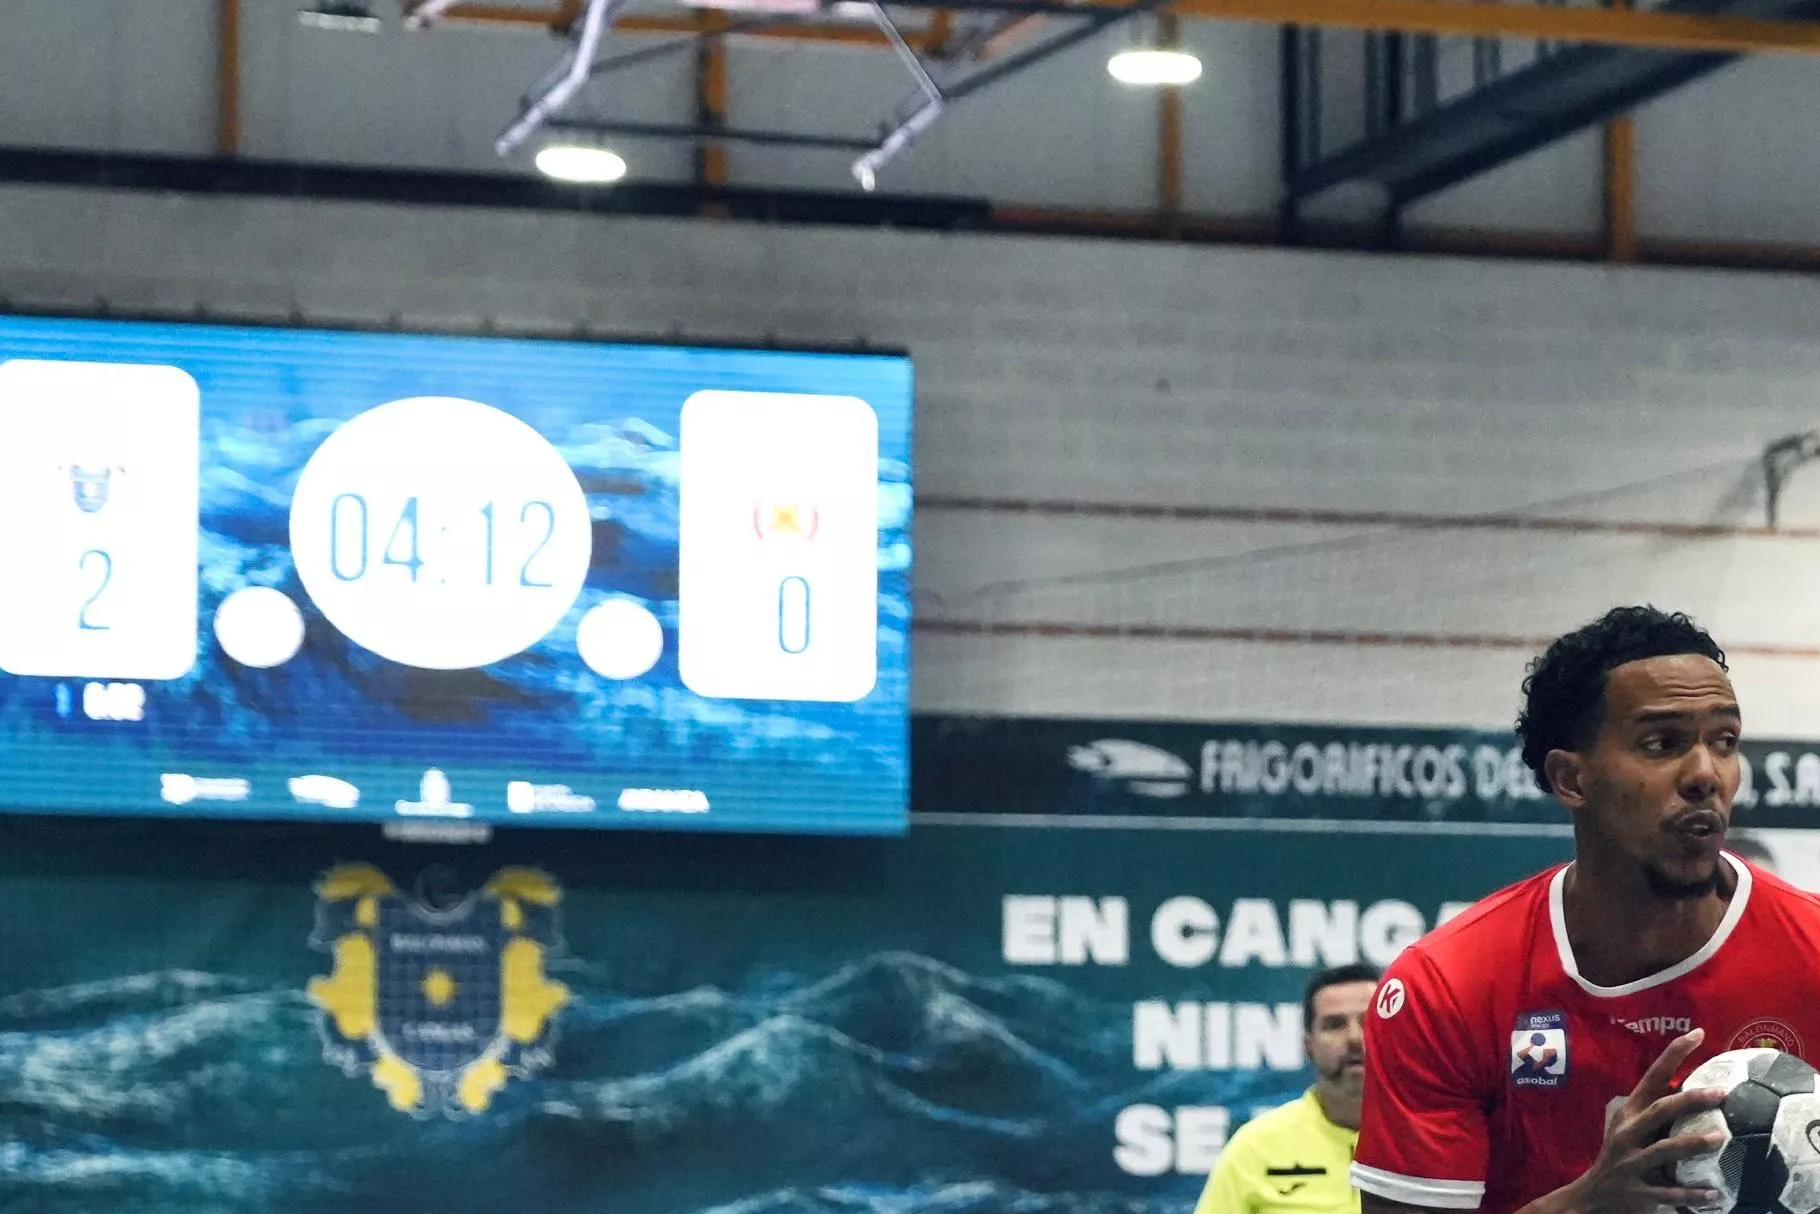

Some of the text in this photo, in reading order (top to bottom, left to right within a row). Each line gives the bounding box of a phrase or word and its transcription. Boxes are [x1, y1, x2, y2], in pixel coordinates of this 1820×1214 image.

[330, 493, 557, 588] 04:12
[77, 549, 114, 631] 2
[779, 576, 811, 655] 0
[1002, 894, 1130, 967] EN
[1516, 1076, 1558, 1086] asobal
